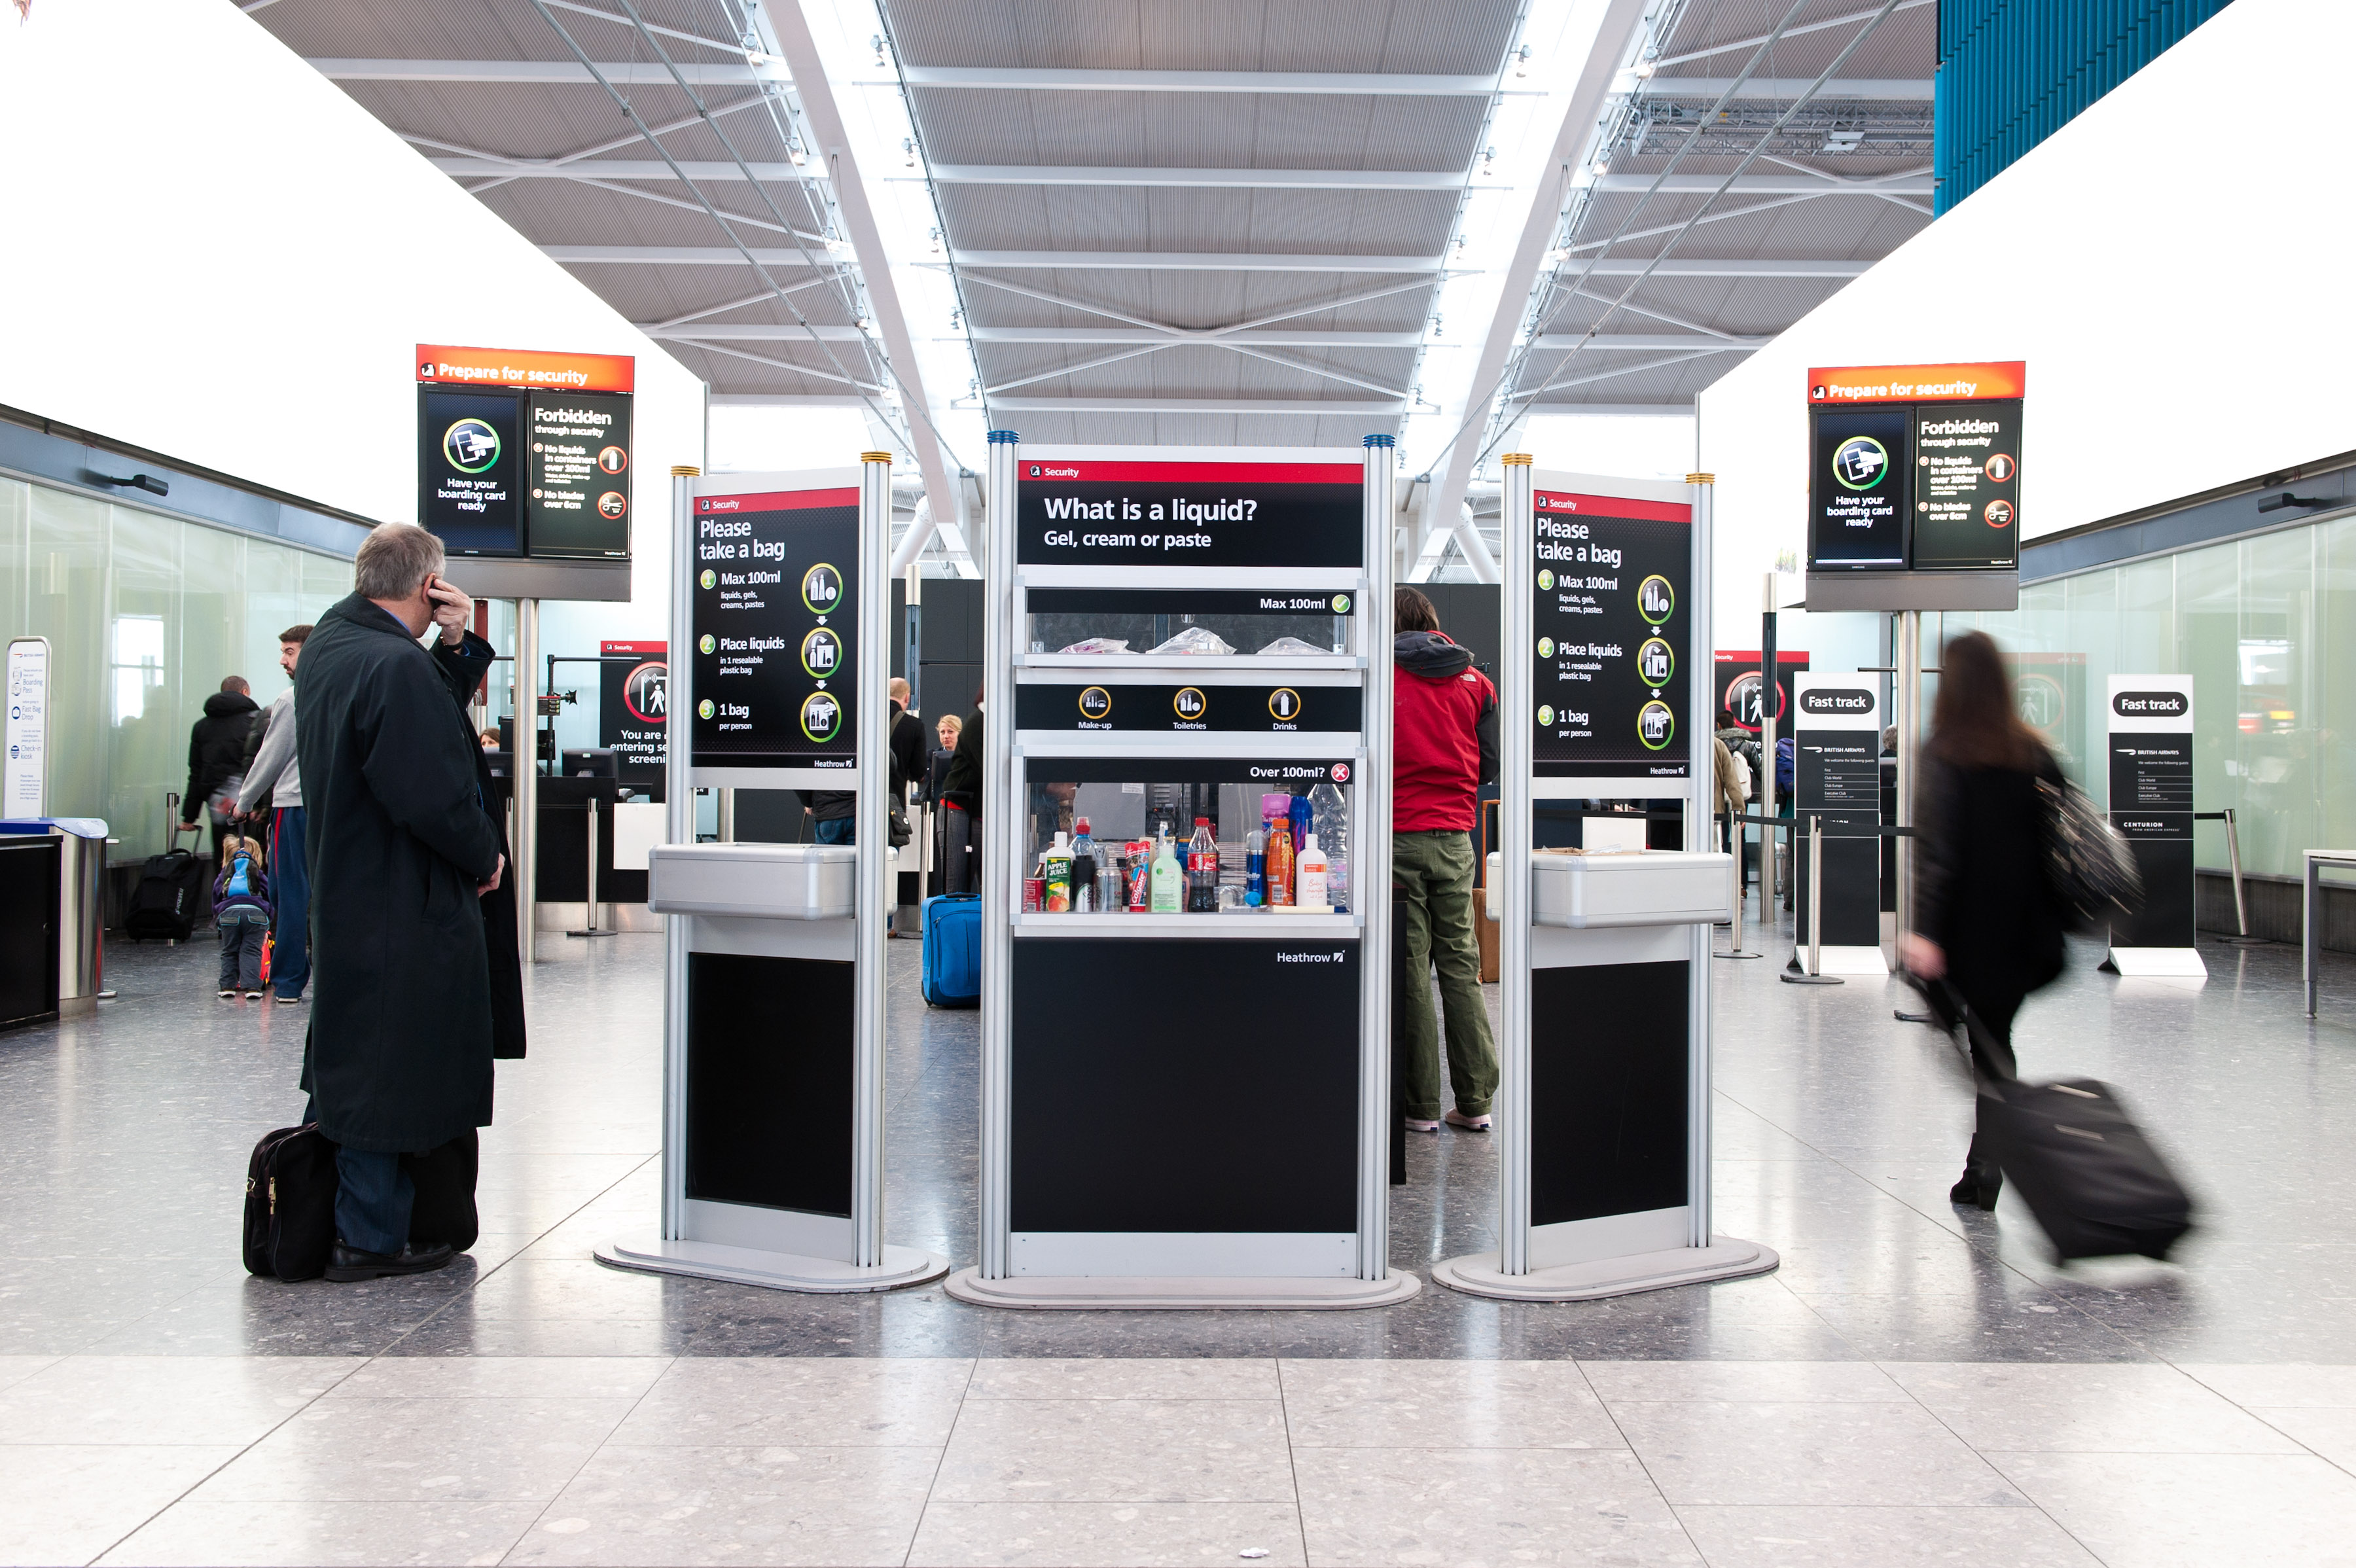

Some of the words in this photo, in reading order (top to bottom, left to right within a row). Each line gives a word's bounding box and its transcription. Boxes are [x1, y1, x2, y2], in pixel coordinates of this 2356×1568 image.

[439, 363, 499, 380] Prepare
[502, 366, 525, 380] for
[527, 370, 588, 386] security
[1829, 385, 1887, 399] Prepare
[1890, 382, 1913, 395] for
[1916, 381, 1976, 396] security
[535, 408, 612, 425] Forbidden
[535, 425, 569, 436] through
[571, 427, 604, 438] security
[1921, 419, 1999, 435] Forbidden
[1920, 437, 1955, 448] through
[1957, 437, 1991, 447] security
[544, 444, 558, 453] No
[558, 445, 586, 455] liquids
[544, 454, 553, 462] in
[554, 455, 597, 464] containers
[1944, 456, 1972, 467] liquids
[565, 464, 590, 472] 100ml
[1044, 467, 1079, 478] Security
[1940, 465, 1983, 474] containers
[447, 478, 472, 488] Have
[474, 480, 497, 490] your
[1951, 475, 1976, 484] 100ml
[438, 489, 482, 501] boarding
[484, 491, 506, 500] card
[544, 490, 557, 499] No
[558, 491, 585, 500] blades
[457, 501, 486, 512] ready
[563, 501, 581, 509] 6cm
[713, 500, 740, 510] Security
[1550, 499, 1577, 510] Security
[1836, 496, 1860, 505] Have
[1861, 497, 1884, 507] your
[1943, 502, 1971, 511] blades
[1044, 497, 1115, 520] What
[1122, 498, 1141, 520] is
[1149, 503, 1164, 520] a
[1173, 499, 1258, 526] liquid?
[1827, 506, 1870, 517] boarding
[1872, 506, 1893, 516] card
[1846, 517, 1873, 528] ready
[700, 519, 751, 538] Please
[1537, 518, 1589, 539] Please
[1044, 530, 1078, 548] Gel,
[1082, 533, 1135, 546] cream
[1141, 534, 1160, 546] or
[1164, 533, 1211, 550] paste
[699, 541, 735, 560] take
[738, 543, 749, 558] a
[753, 539, 785, 561] bag
[1537, 541, 1573, 561] take
[1577, 547, 1587, 561] a
[1591, 543, 1622, 569] bag
[721, 573, 745, 585] Max
[747, 570, 781, 584] 100ml
[1559, 575, 1583, 588] Max
[1586, 577, 1618, 590] 100ml
[721, 591, 742, 600] liquids,
[743, 590, 758, 600] gels,
[1559, 594, 1580, 603] liquids,
[1581, 596, 1596, 604] gels,
[745, 601, 764, 610] pastes
[1260, 598, 1286, 609] Max
[1289, 598, 1325, 609] 100ml
[1583, 606, 1603, 615] pastes
[721, 637, 747, 650] Place
[749, 636, 785, 652] liquids
[1560, 642, 1586, 655] Place
[1588, 643, 1622, 659] liquids
[732, 656, 763, 664] resealable
[720, 666, 740, 675] plastic
[740, 666, 752, 675] bag
[1559, 671, 1579, 681] plastic
[1579, 672, 1591, 681] bag
[1809, 696, 1833, 707] Fast
[1836, 696, 1866, 707] track
[2122, 699, 2146, 710] Fast
[2149, 699, 2179, 710] track
[720, 704, 726, 715] 1
[728, 703, 749, 719] bag
[1559, 710, 1566, 722] 1
[1569, 709, 1588, 725] bag
[1078, 722, 1112, 730] Make-up
[621, 730, 641, 739] You
[610, 741, 654, 753] entering
[629, 754, 666, 764] screeni
[1250, 766, 1279, 777] Over
[1283, 766, 1325, 777] 100ml?
[1048, 862, 1067, 870] APPLE
[1049, 868, 1067, 876] JUICE
[1132, 872, 1146, 903] Colgate
[1277, 952, 1330, 962] Heathrow
